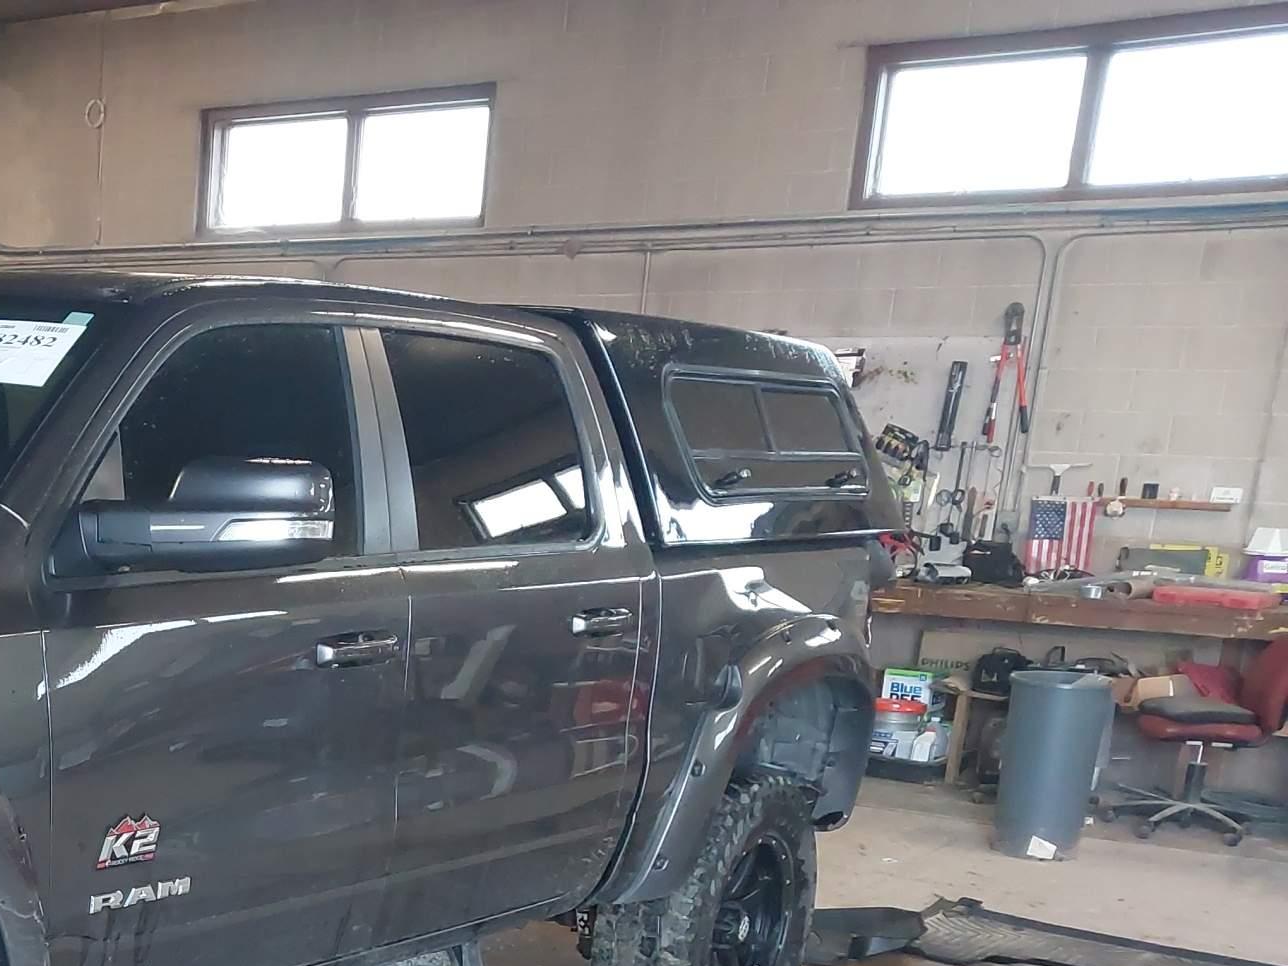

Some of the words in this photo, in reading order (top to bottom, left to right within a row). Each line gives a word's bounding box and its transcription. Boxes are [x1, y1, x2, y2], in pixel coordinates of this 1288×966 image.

[921, 658, 970, 671] PHILIPS
[890, 682, 922, 695] Blue
[98, 827, 160, 863] K2
[88, 876, 192, 914] RAM
